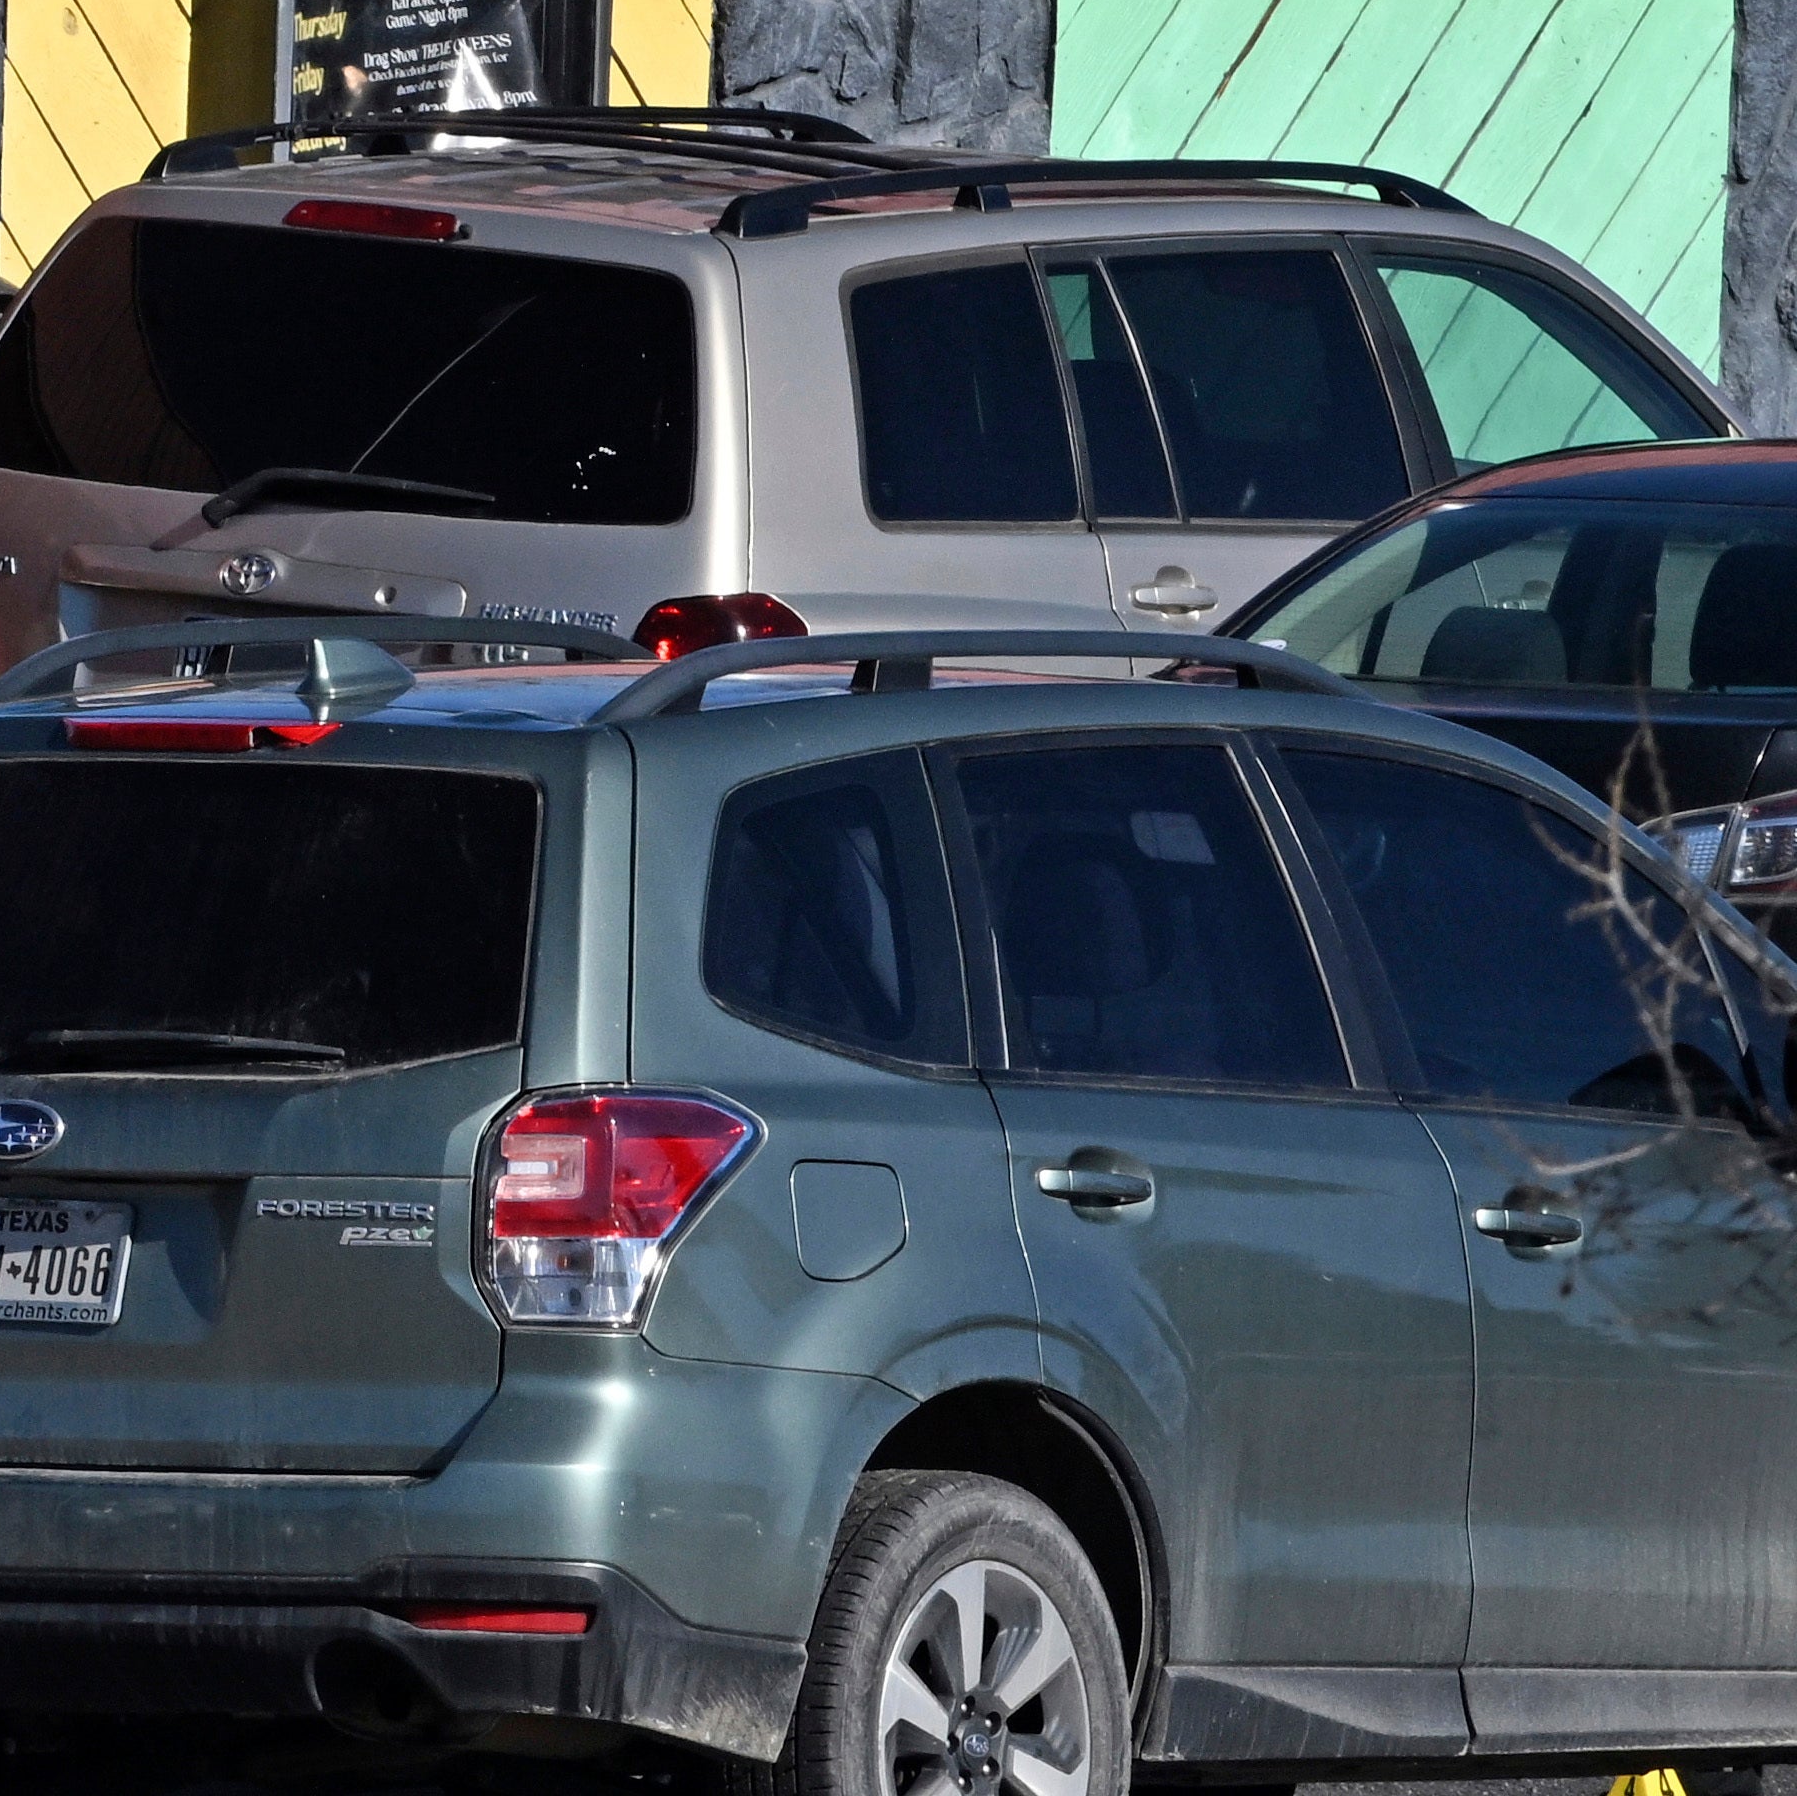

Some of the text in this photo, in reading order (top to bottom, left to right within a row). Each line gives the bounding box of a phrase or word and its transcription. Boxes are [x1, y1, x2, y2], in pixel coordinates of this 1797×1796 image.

[294, 5, 347, 42] Thursday
[385, 6, 469, 30] Game Night 8pm
[364, 51, 390, 70] Drag
[256, 1198, 435, 1222] FORESTER
